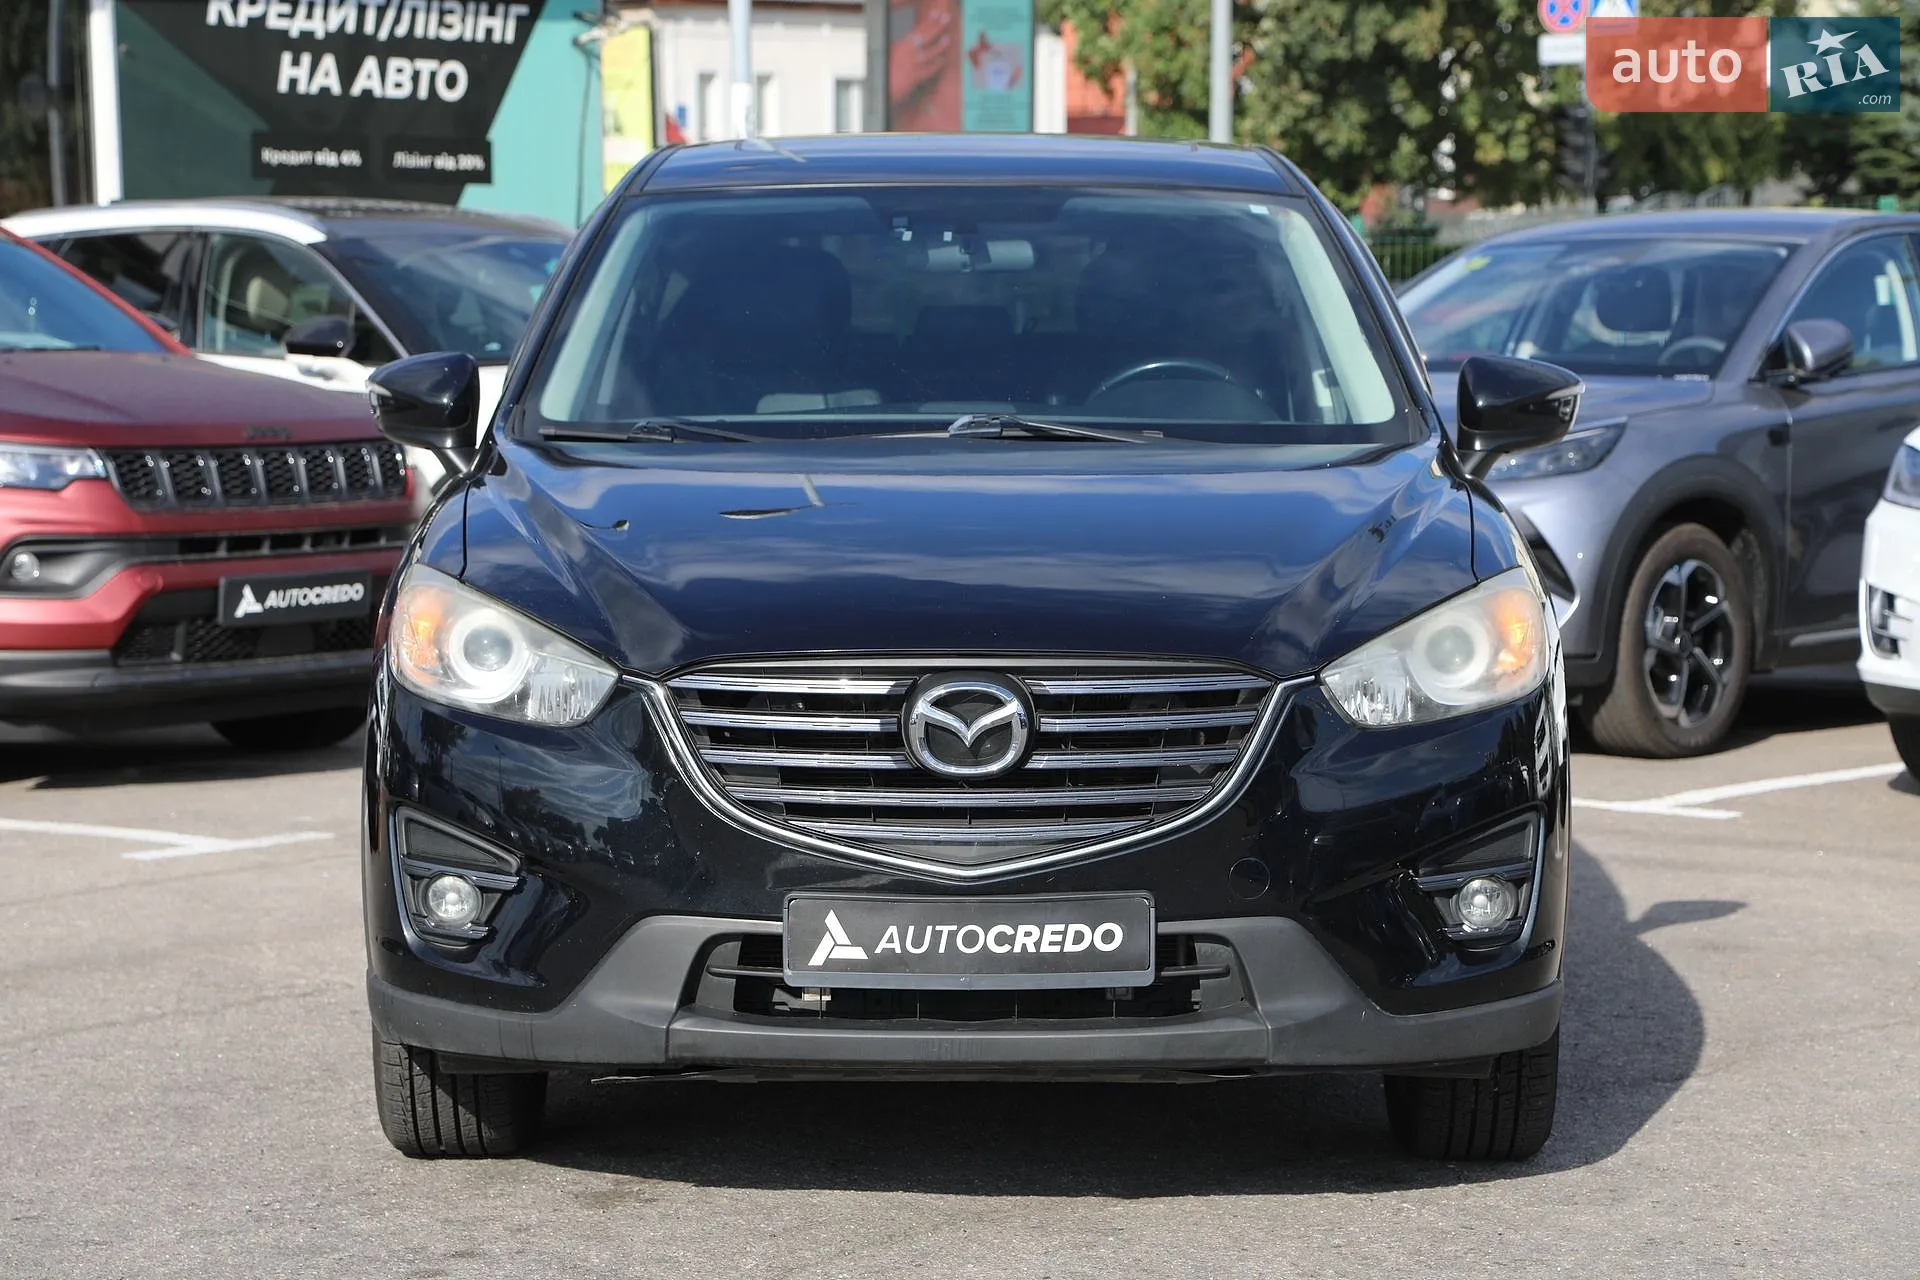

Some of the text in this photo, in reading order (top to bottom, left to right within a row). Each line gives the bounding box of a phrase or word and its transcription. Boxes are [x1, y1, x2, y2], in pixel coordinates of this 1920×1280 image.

[205, 0, 530, 44] КРЕДИТ/ЛІЗІНГ
[276, 50, 469, 102] НА АВТО
[264, 582, 365, 609] AUTOCREDO
[874, 922, 1124, 954] AUTOCREDO
